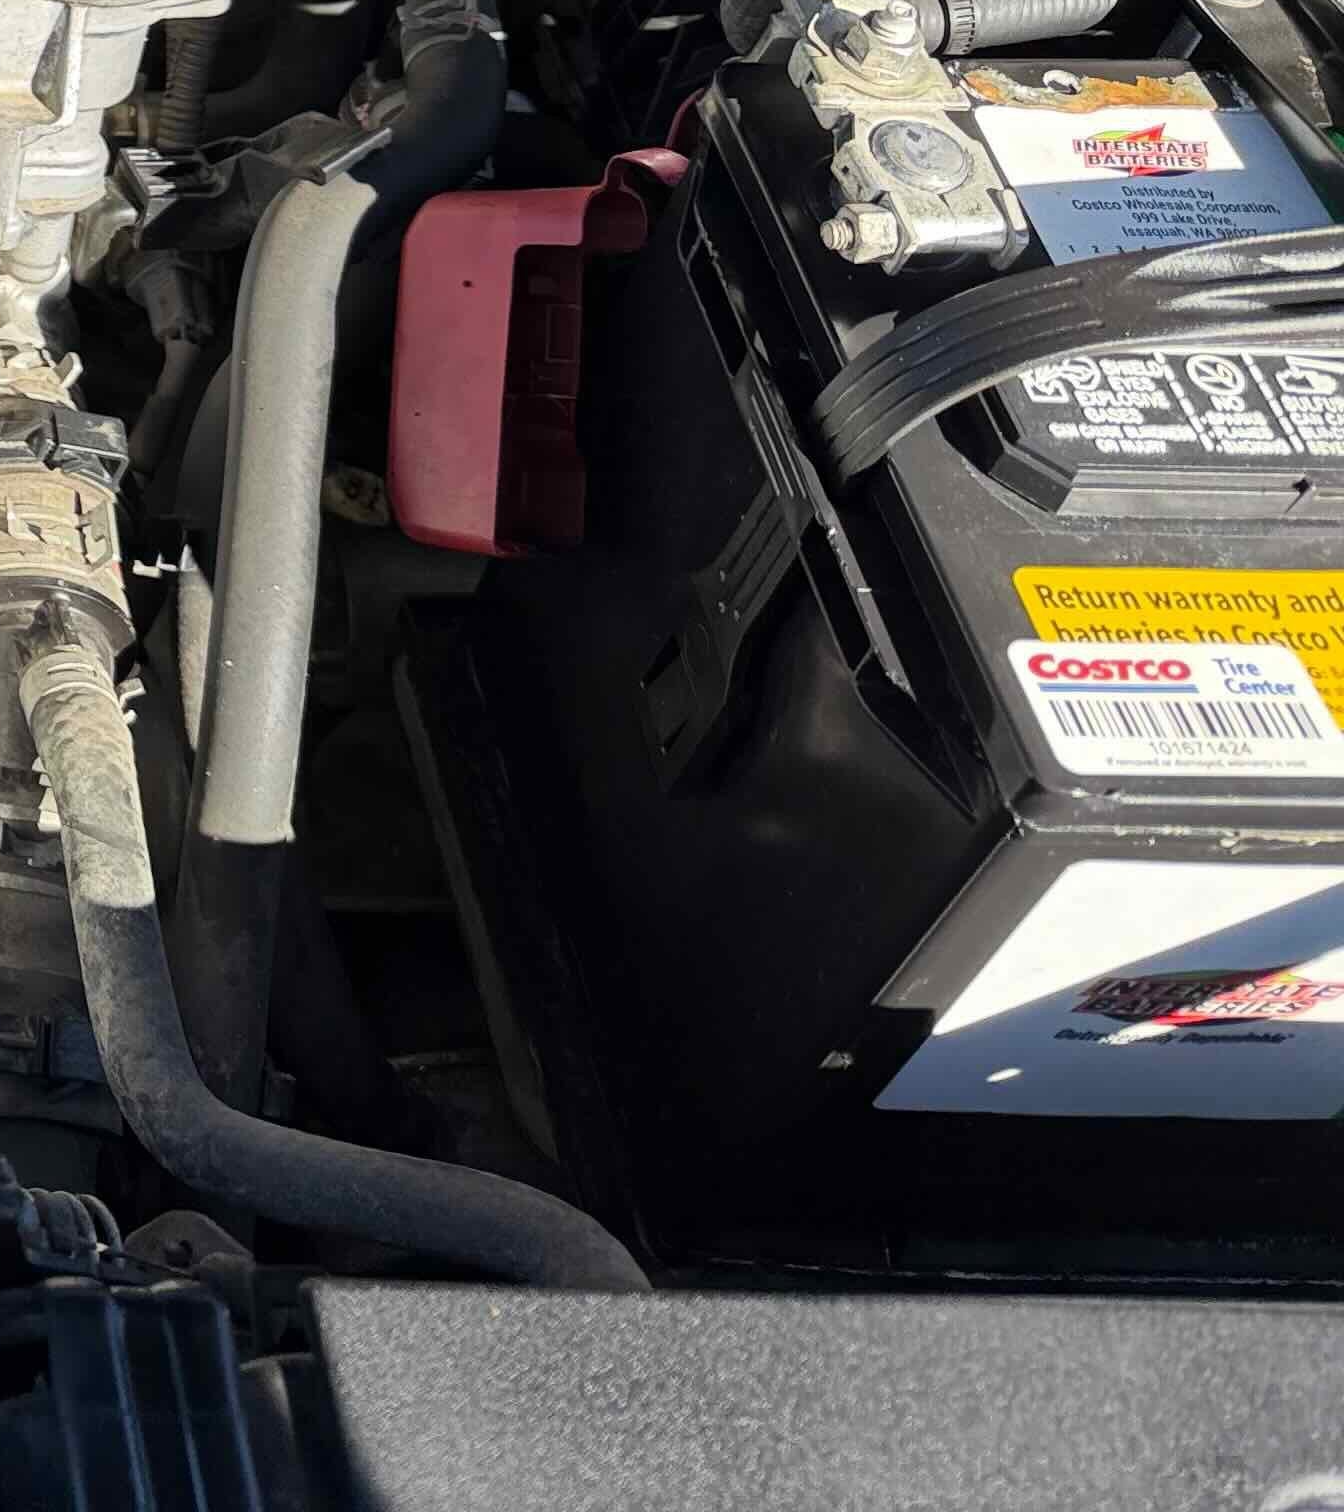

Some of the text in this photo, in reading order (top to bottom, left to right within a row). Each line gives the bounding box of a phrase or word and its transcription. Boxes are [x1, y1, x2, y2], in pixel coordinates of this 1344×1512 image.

[1074, 139, 1203, 155] INTERSTATE
[1087, 154, 1204, 168] BATTERIES
[1122, 186, 1215, 201] Distributed by
[1072, 199, 1281, 215] Costco Wholesale Corporation,
[1132, 212, 1237, 227] 999 Lake Drive,
[1121, 226, 1191, 239] Issaquah,
[1193, 227, 1216, 239] WA
[1211, 395, 1245, 411] NO
[1033, 584, 1344, 620] Return warranty and
[1231, 624, 1329, 651] Costco
[1027, 653, 1192, 681] COSTCO
[1211, 657, 1261, 676] Tire
[1224, 678, 1297, 696] Center
[1149, 740, 1253, 756] 101671424
[1092, 978, 1343, 1000] INTERTATE
